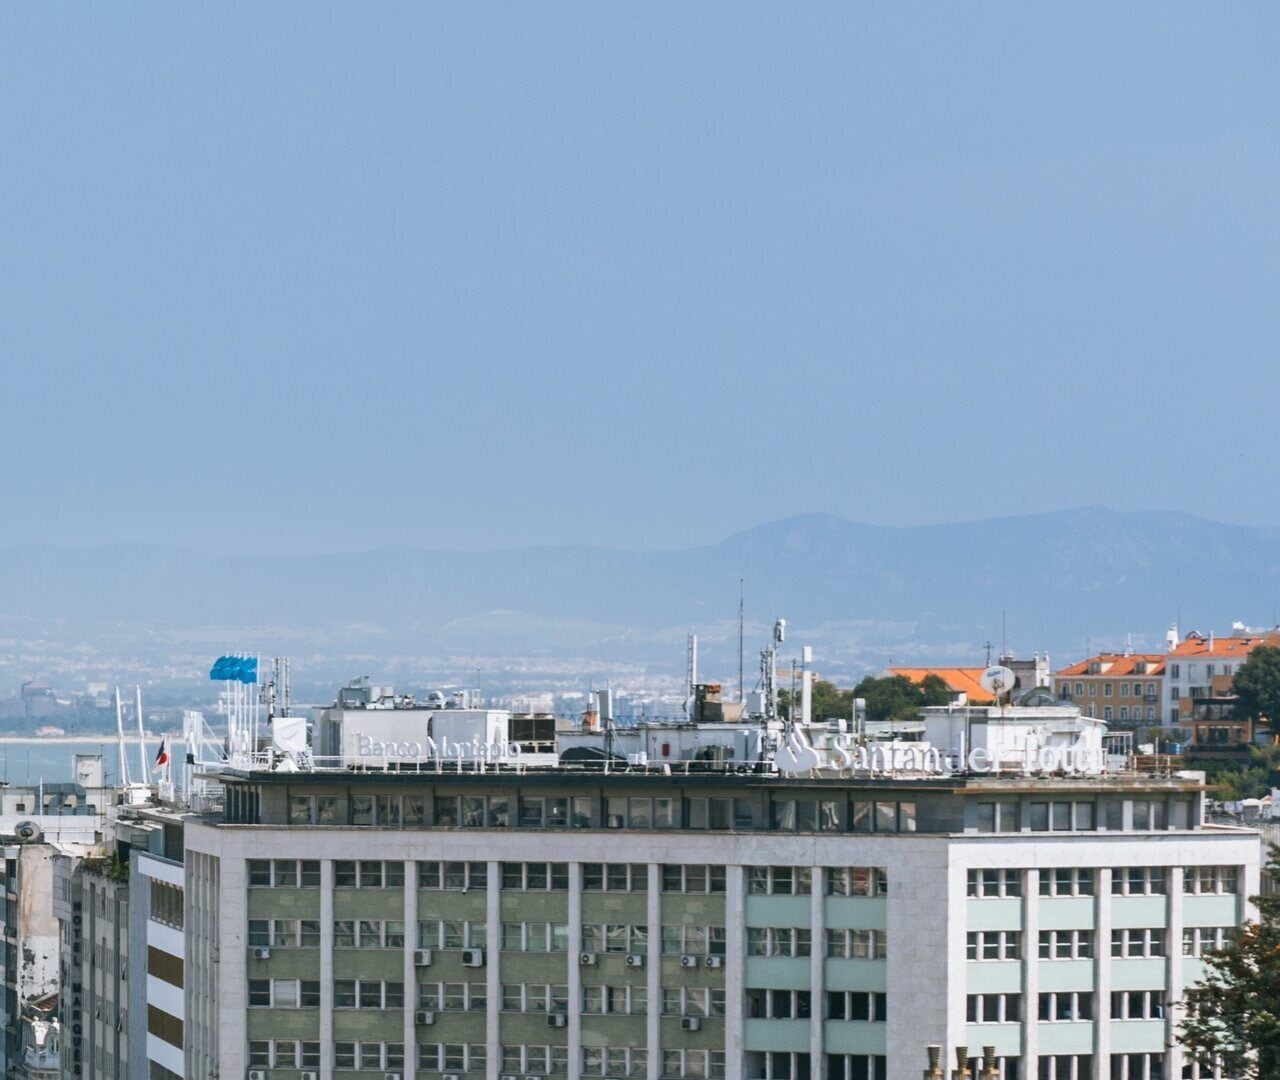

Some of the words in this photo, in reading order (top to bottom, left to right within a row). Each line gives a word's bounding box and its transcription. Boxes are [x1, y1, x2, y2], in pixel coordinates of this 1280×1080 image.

[359, 736, 421, 757] Banco
[427, 735, 522, 759] Montepio
[831, 731, 1001, 773] Santander
[72, 901, 82, 967] HOTEL
